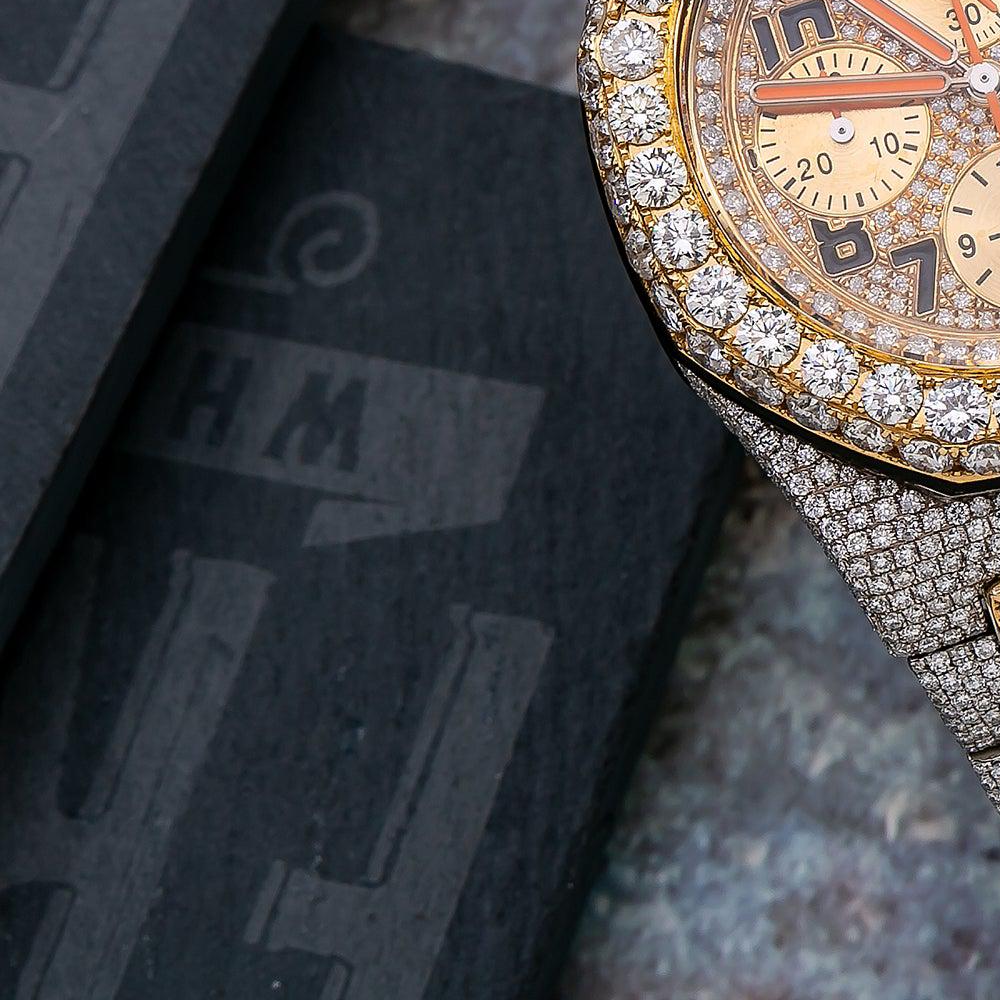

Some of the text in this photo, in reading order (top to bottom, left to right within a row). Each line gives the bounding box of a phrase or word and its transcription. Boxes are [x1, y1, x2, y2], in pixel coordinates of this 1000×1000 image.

[946, 3, 981, 31] 30
[870, 132, 900, 158] 10
[797, 152, 833, 181] 20
[957, 233, 977, 258] 9
[889, 235, 938, 316] 7
